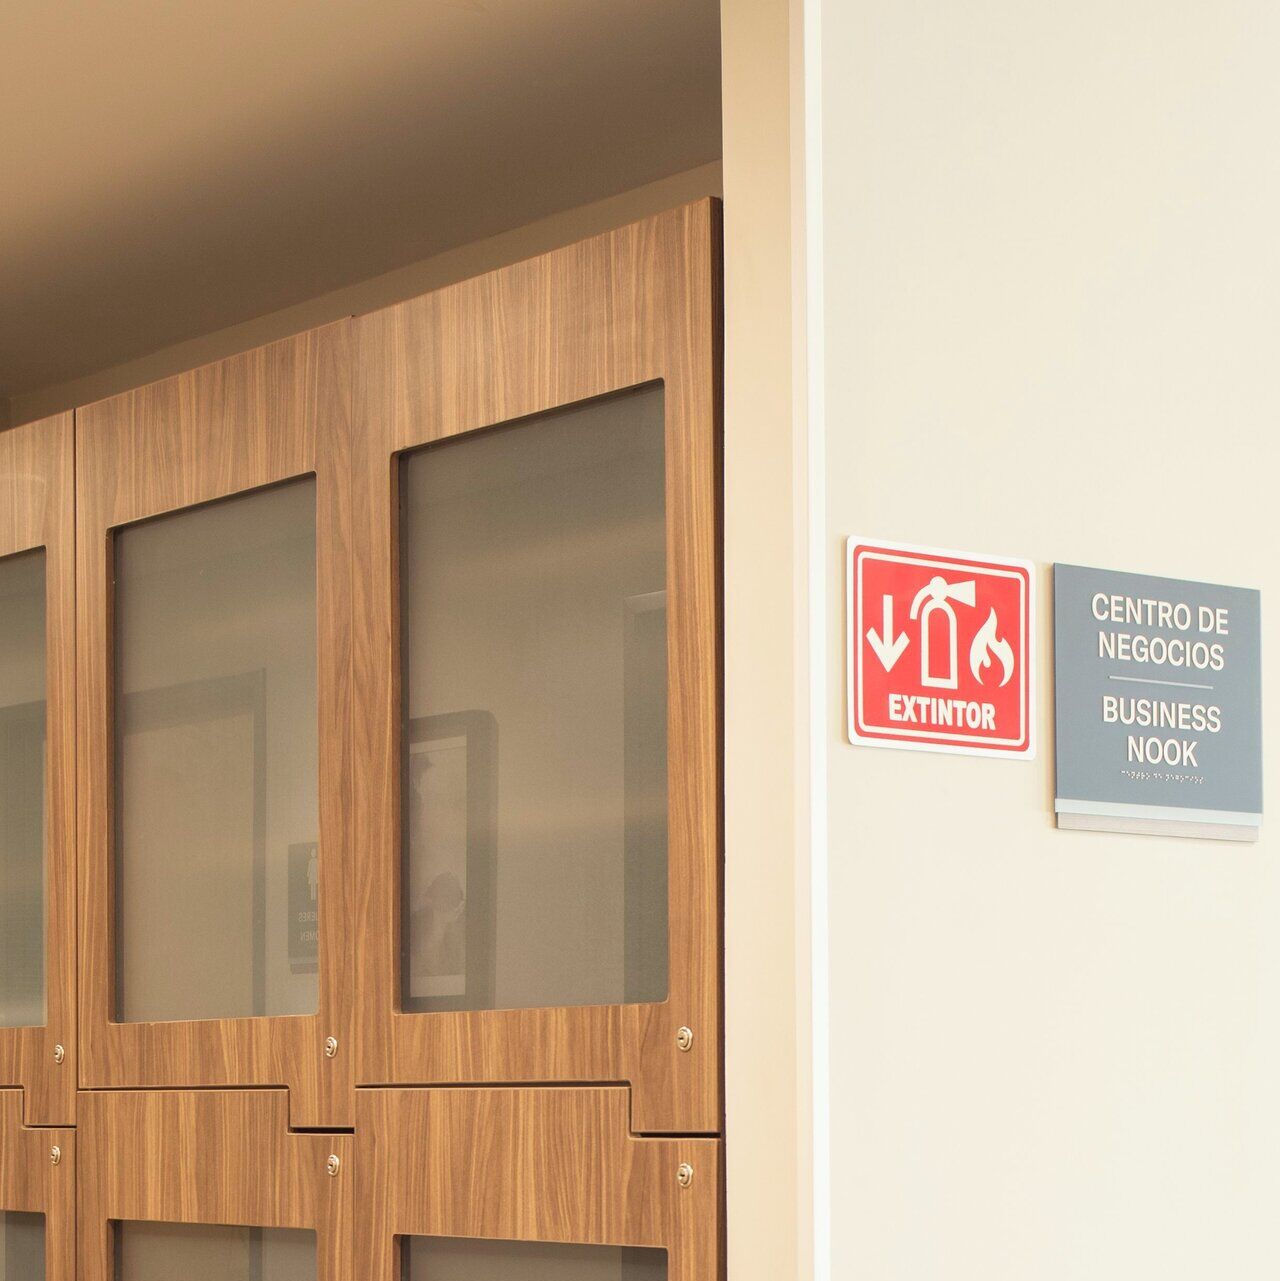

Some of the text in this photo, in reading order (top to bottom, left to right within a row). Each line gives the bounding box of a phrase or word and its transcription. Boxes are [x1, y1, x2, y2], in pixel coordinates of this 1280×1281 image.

[1092, 592, 1229, 635] CENTRO DE
[1098, 631, 1225, 671] NEGOCIOS
[888, 693, 996, 731] EXTINTOR
[1102, 695, 1221, 733] BUSINESS
[1127, 735, 1198, 768] NOOK
